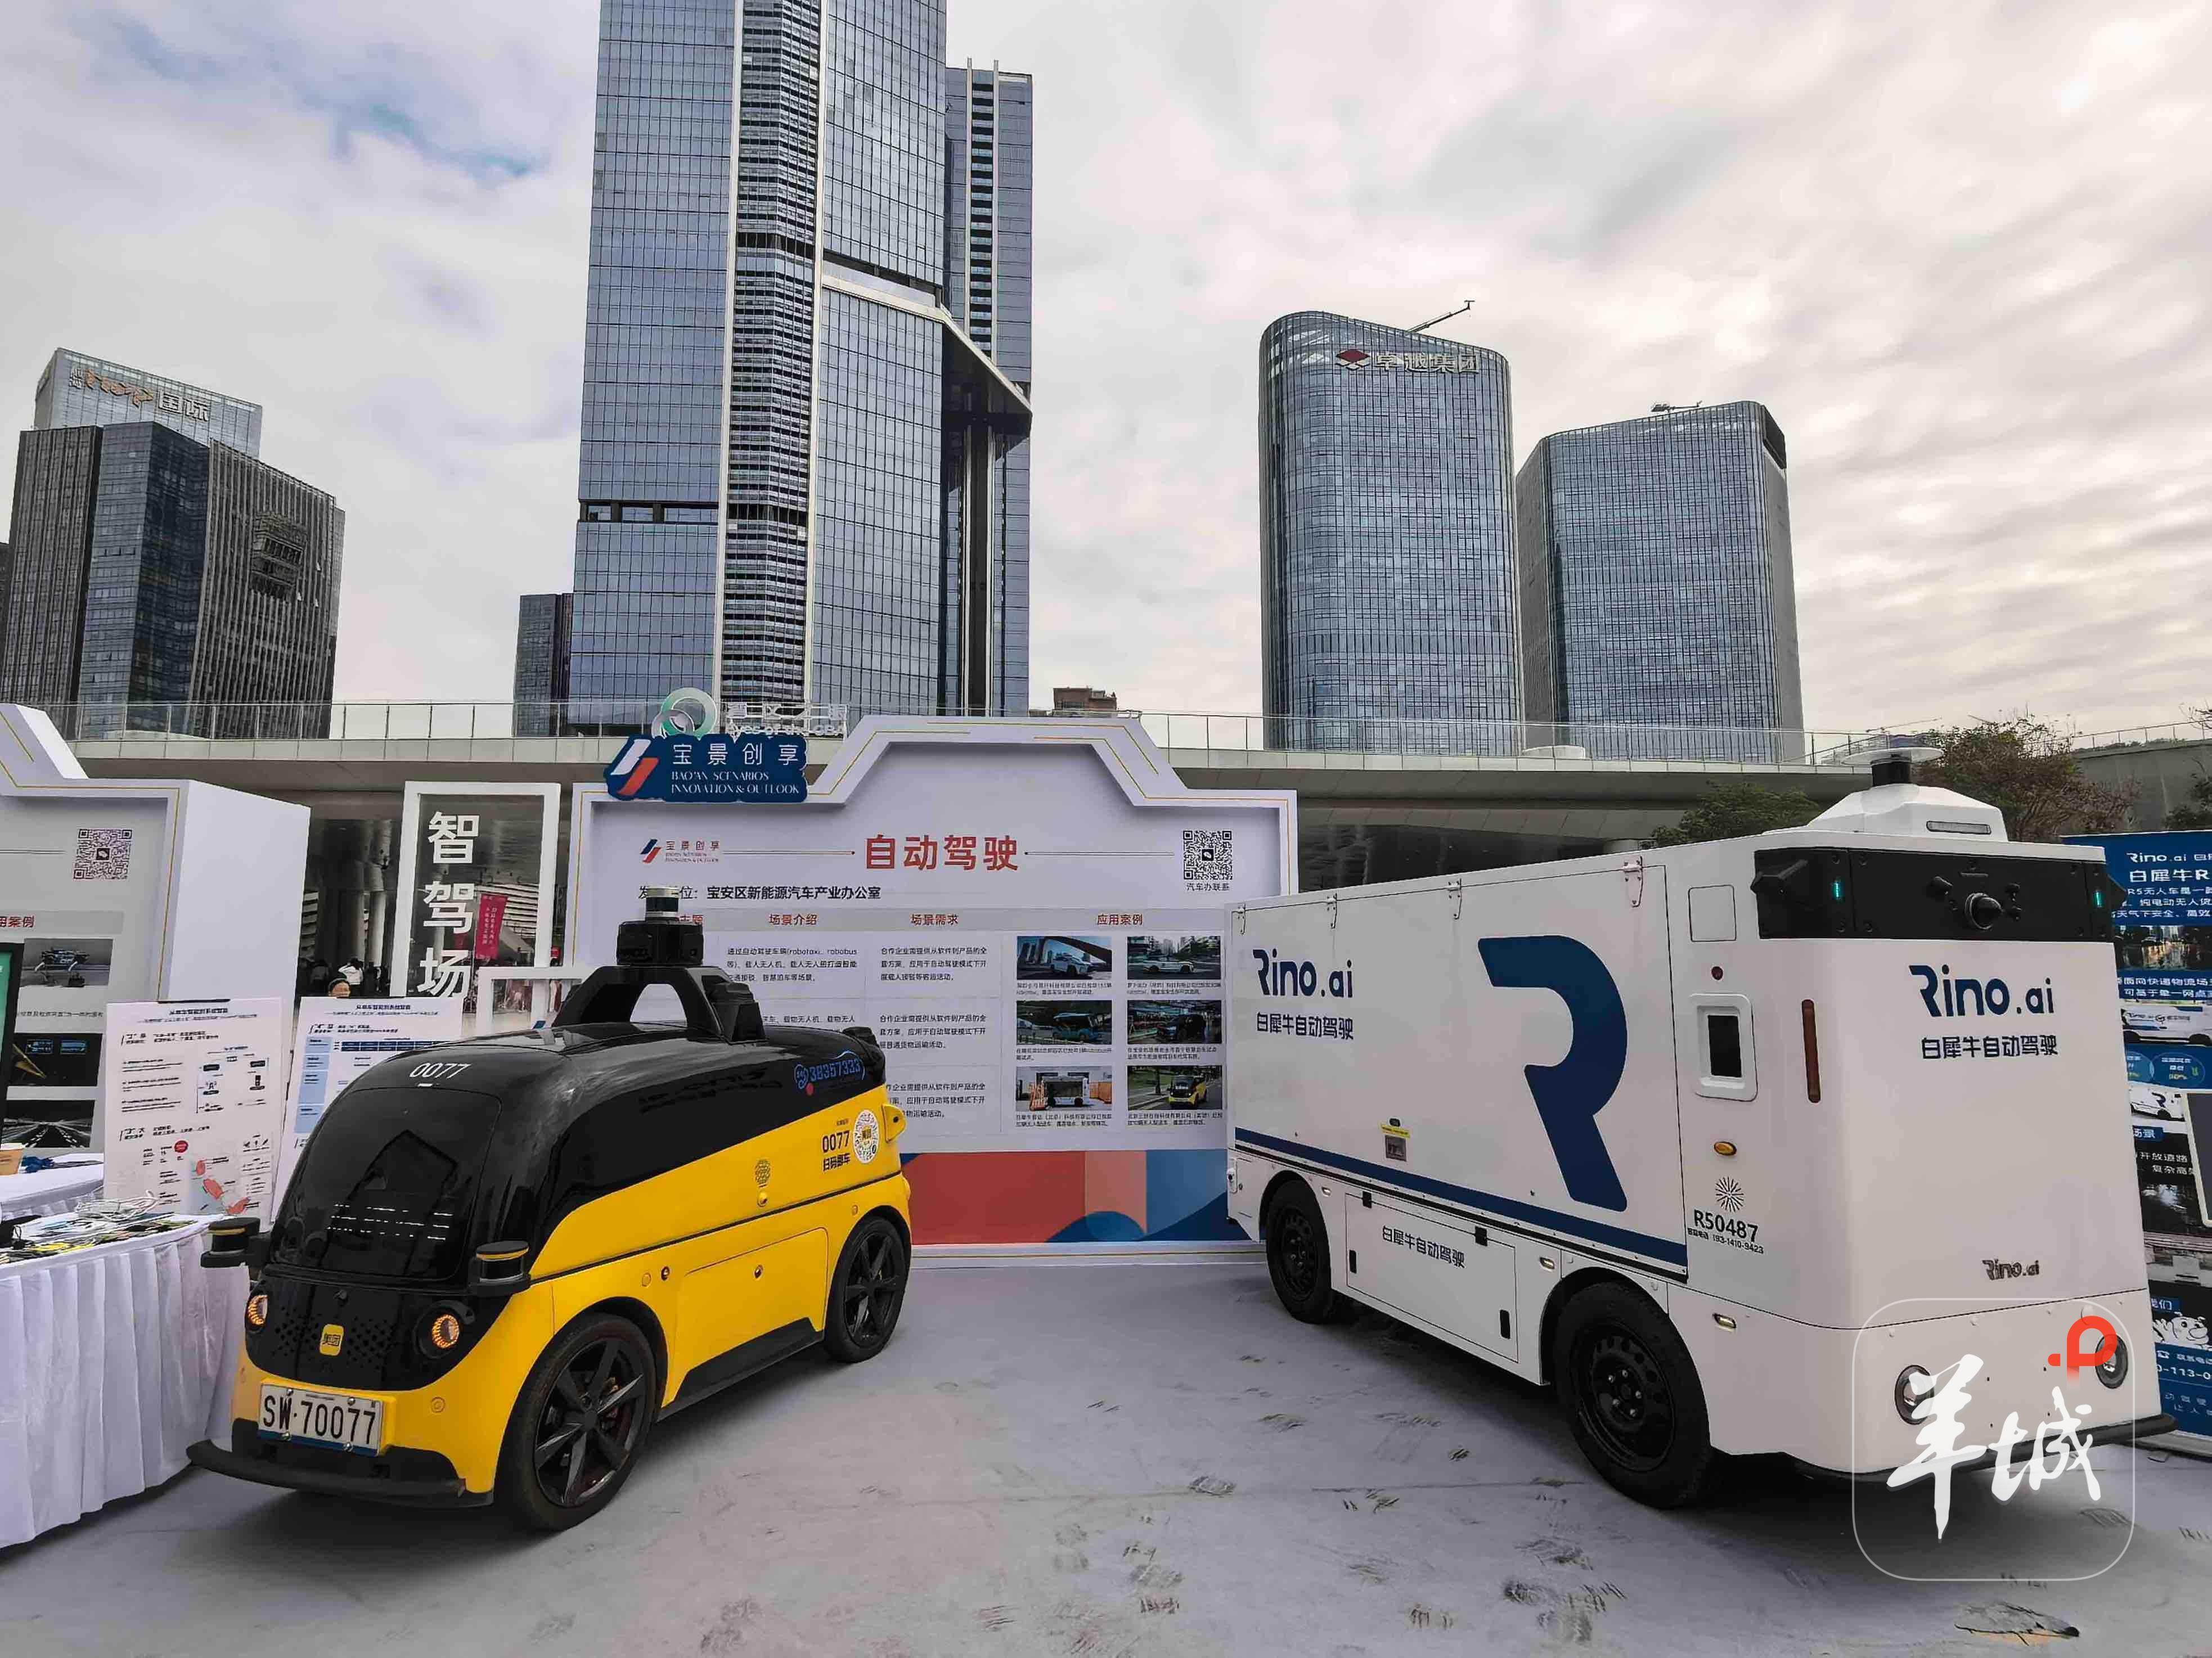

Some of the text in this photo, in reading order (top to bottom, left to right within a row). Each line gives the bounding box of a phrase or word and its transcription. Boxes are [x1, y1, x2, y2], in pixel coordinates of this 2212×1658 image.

[672, 742, 798, 765] 宝景创享
[865, 833, 1018, 871] 自动驾驶
[2126, 852, 2187, 863] Rino.ai
[707, 885, 881, 900] 宝安区新能源汽车产业办公室
[768, 913, 818, 925] 场景介绍
[910, 913, 959, 925] 场景需求
[1097, 913, 1144, 926] 应用案例
[1252, 948, 1353, 998] Rino.ai
[1908, 964, 2054, 1017] Rino.ai
[1256, 1012, 1354, 1040] 白犀牛自动驾驶
[1921, 1035, 2058, 1060] 白犀牛自动驾驶
[409, 1062, 471, 1079] 0077
[822, 1130, 850, 1153] 0077
[1694, 1209, 1759, 1243] R50487
[1382, 1224, 1465, 1268] 白犀牛自动驾驶
[1982, 1259, 2040, 1281] Rino.ai
